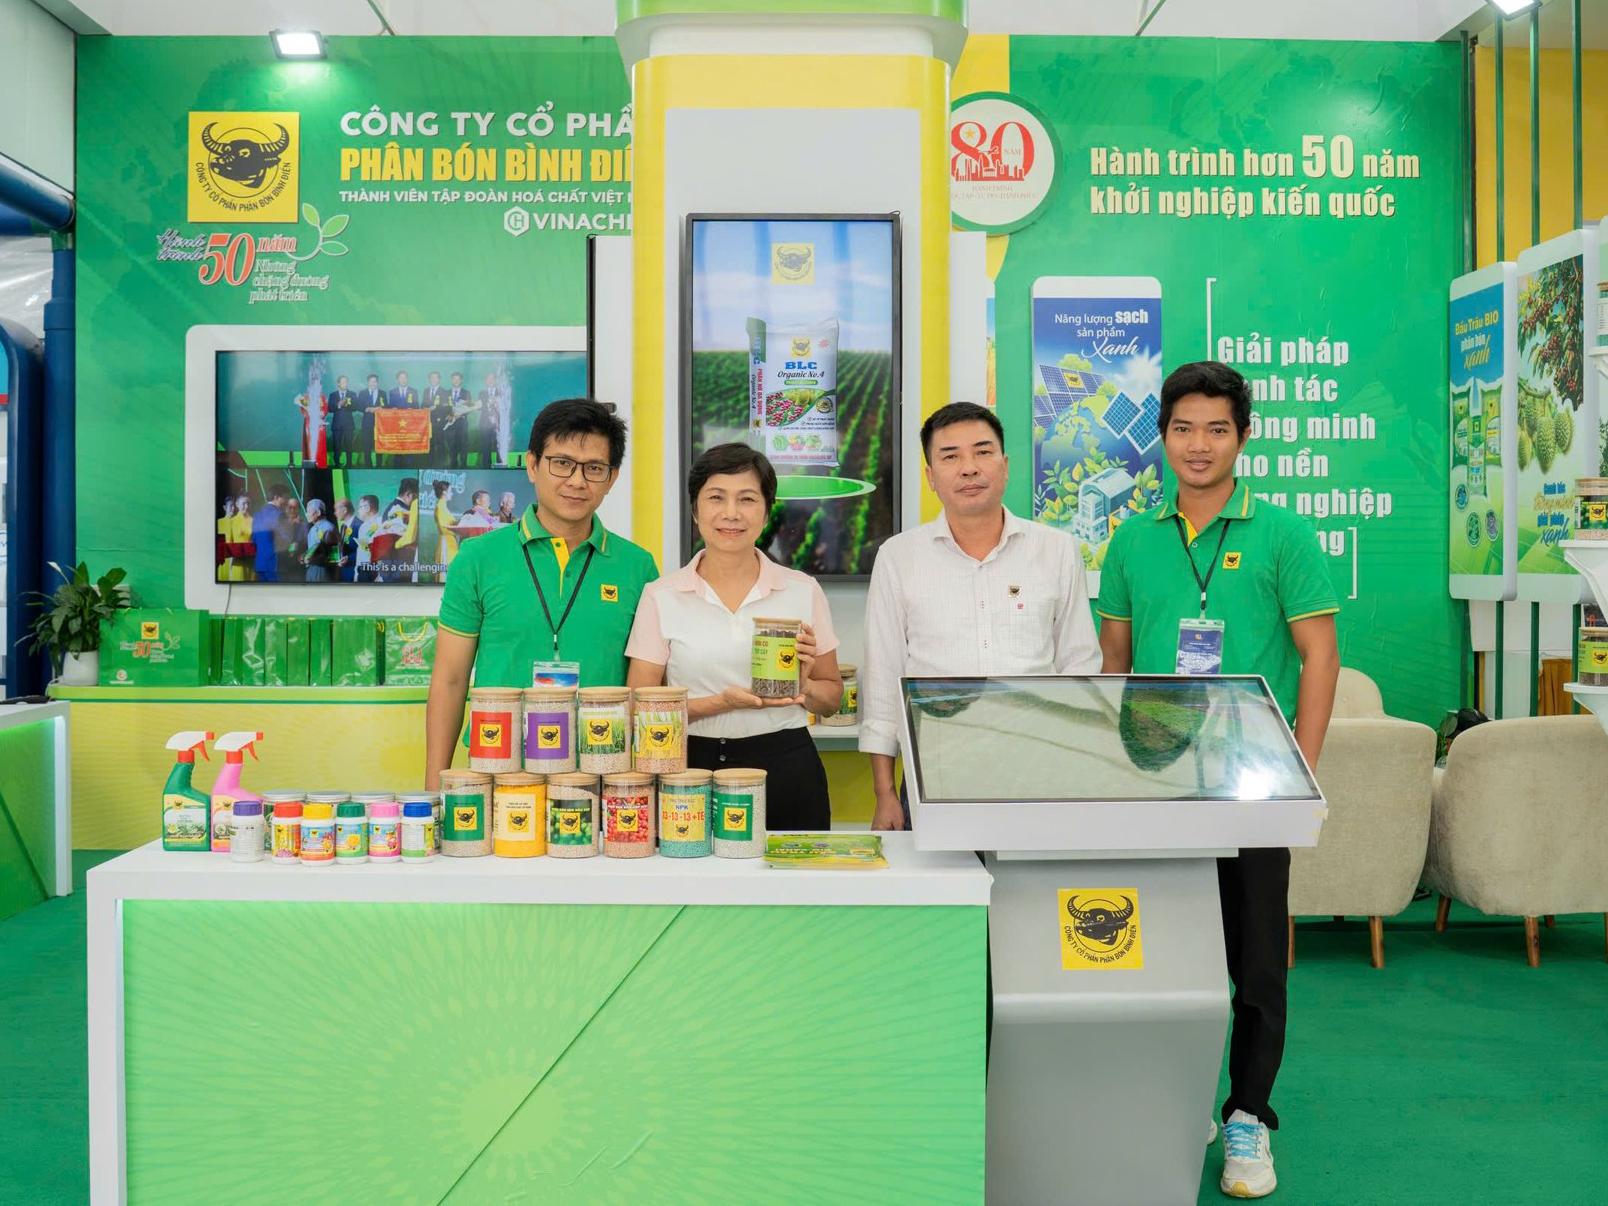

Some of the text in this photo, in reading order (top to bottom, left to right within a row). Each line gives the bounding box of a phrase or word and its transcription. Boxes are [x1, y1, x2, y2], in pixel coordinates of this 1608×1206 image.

[340, 104, 439, 137] CÔNG
[451, 111, 496, 136] TY
[506, 101, 555, 137] CỔ
[340, 141, 424, 182] PHÂN
[432, 141, 497, 182] BÓN
[505, 142, 582, 182] BÌNH
[1091, 134, 1420, 179] Hành trình hơn 50 năm
[339, 188, 390, 202] THÀNH
[394, 188, 428, 202] VIÊN
[432, 188, 459, 205] TẬP
[464, 188, 508, 203] ĐOÀN
[513, 188, 544, 203] HOÁ
[548, 188, 588, 203] CHẤT
[592, 189, 624, 206] VIỆT
[1090, 182, 1396, 219] khởi nghiệp kiến quốc
[256, 234, 297, 252] năm
[199, 233, 255, 286] 50
[1084, 313, 1113, 326] lượng
[1115, 308, 1149, 326] sạch
[1484, 310, 1499, 326] BIO
[1077, 326, 1126, 339] sản phẩm
[1217, 332, 1349, 367] Giải pháp
[777, 370, 807, 380] Organic
[785, 361, 817, 370] BLC
[1294, 374, 1338, 401] tác
[1307, 413, 1375, 439] minh
[1278, 447, 1329, 477] nền
[1296, 487, 1392, 519] nghiệp
[362, 562, 380, 572] This
[382, 562, 389, 572] is
[398, 562, 448, 574] challengin
